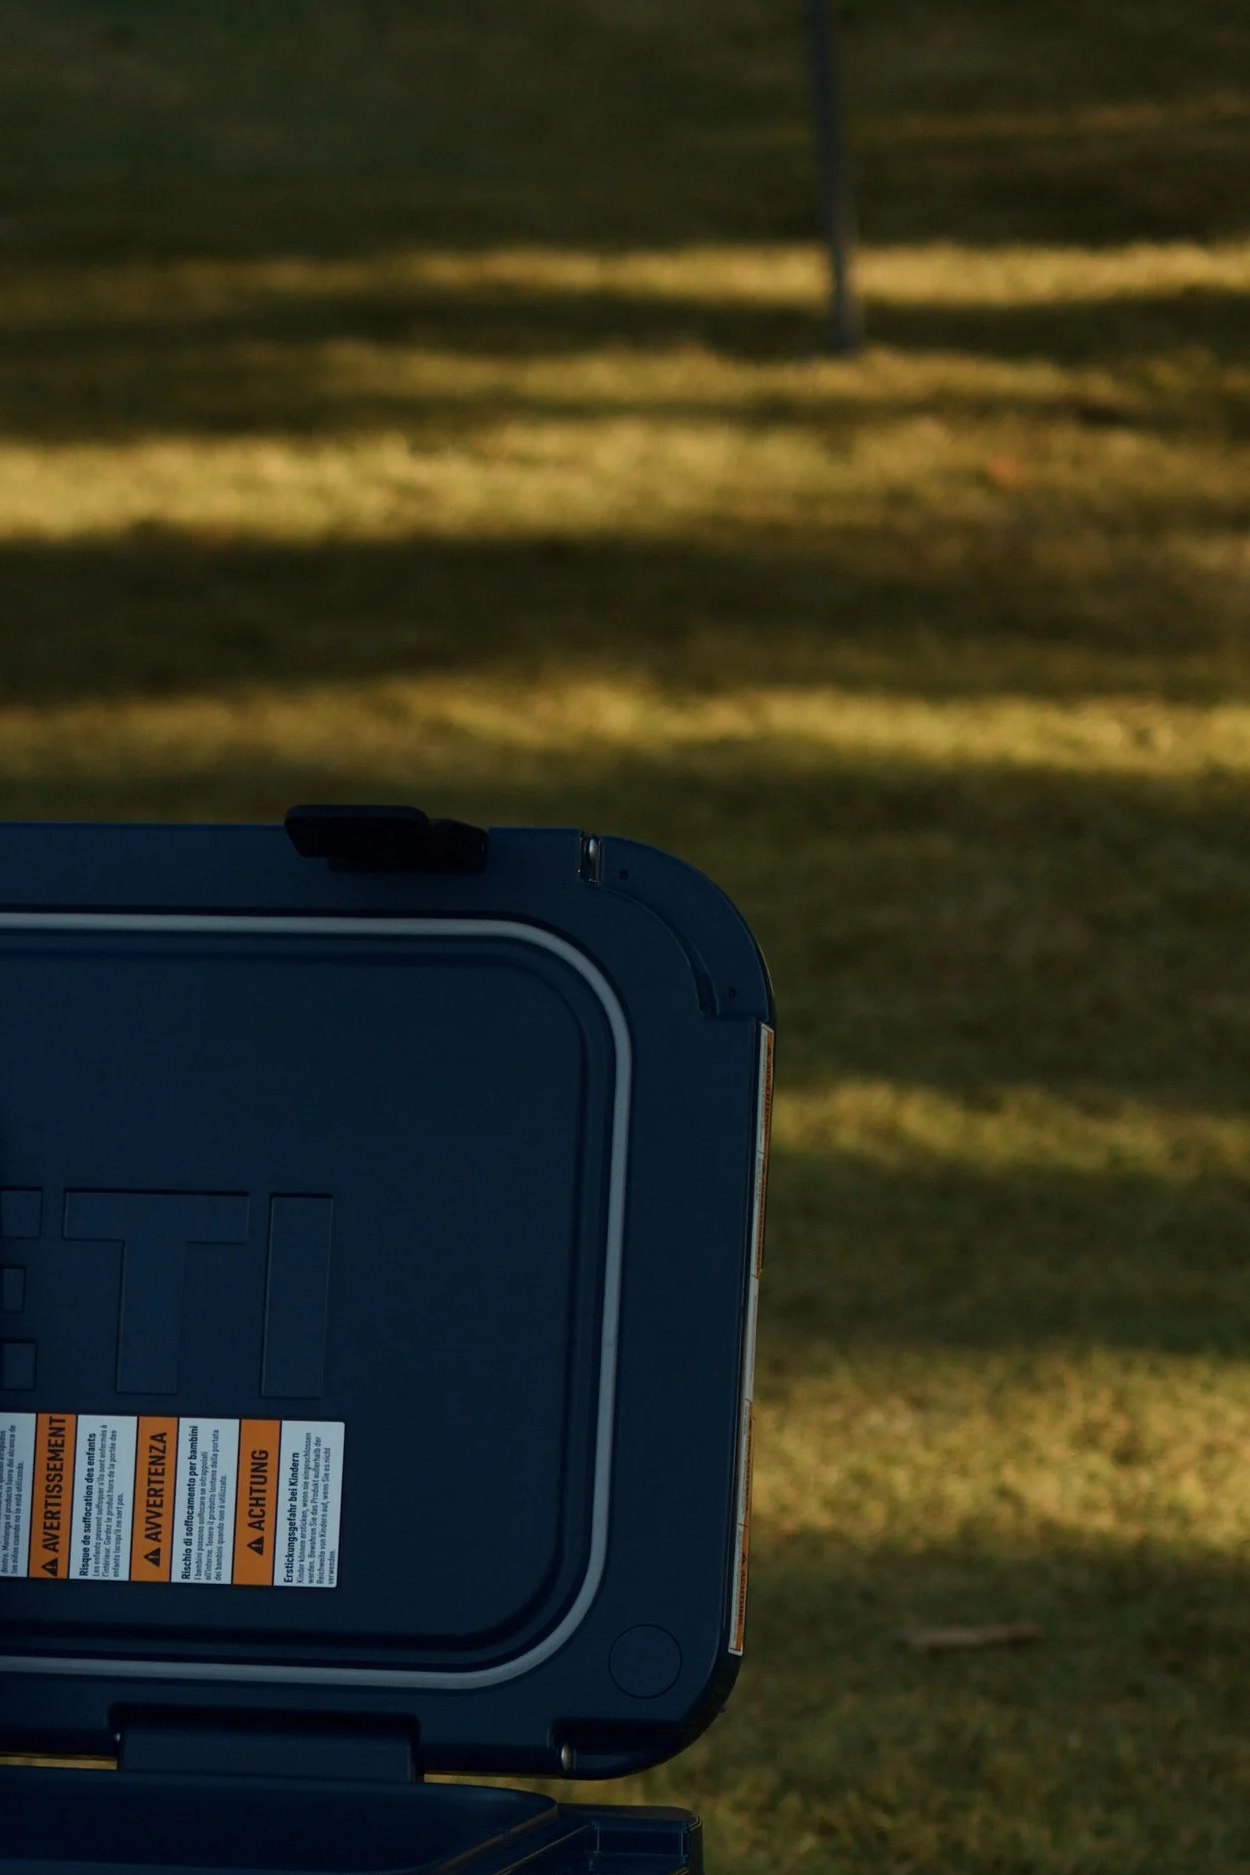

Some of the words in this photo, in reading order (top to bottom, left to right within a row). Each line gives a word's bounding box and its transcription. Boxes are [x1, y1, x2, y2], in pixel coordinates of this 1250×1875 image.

[85, 1432, 95, 1465] enfants
[187, 1425, 198, 1459] bambini
[41, 1415, 65, 1552] AVERTISSEMENT
[84, 1467, 93, 1483] des
[188, 1461, 198, 1476] per
[288, 1452, 299, 1486] Kindern
[144, 1431, 167, 1542] AVVERTENZA
[247, 1449, 268, 1531] ACHTUNG
[287, 1488, 297, 1501] bei
[81, 1484, 93, 1533] suffocation
[183, 1477, 195, 1536] soffocamento
[81, 1534, 90, 1545] de
[182, 1538, 192, 1546] di
[283, 1503, 299, 1582] Erstickungsgefahr
[79, 1547, 92, 1576] Risque
[181, 1548, 191, 1579] Rischio
